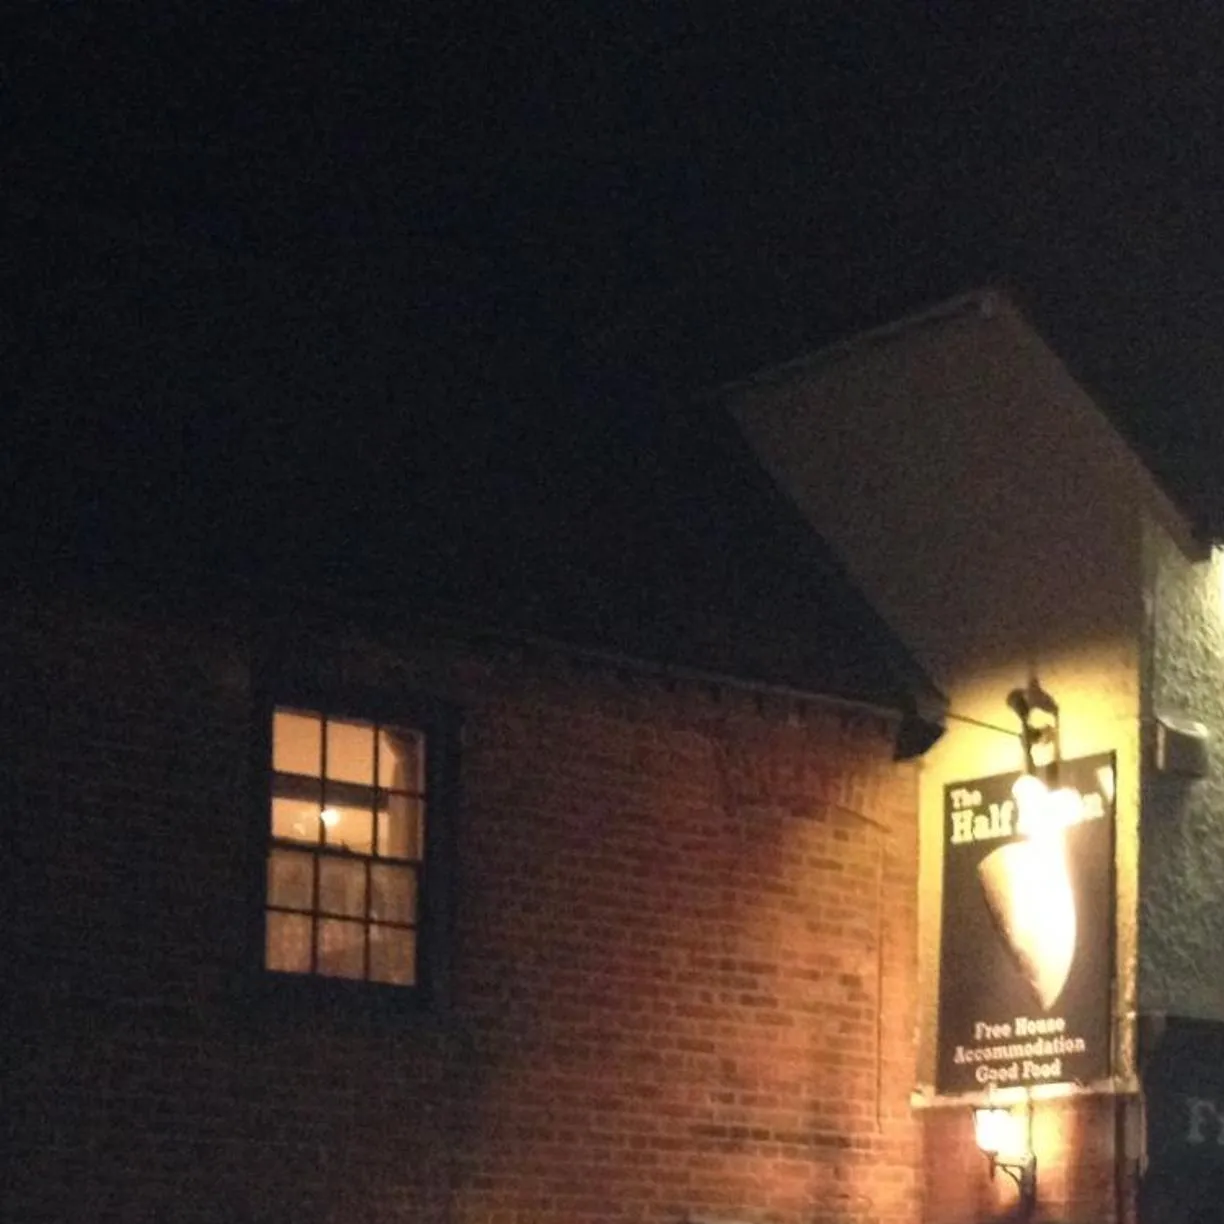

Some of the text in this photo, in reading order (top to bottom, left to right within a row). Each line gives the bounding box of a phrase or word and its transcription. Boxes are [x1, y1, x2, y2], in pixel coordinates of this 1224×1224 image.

[951, 788, 981, 809] The
[951, 801, 1014, 844] Half
[975, 1016, 1065, 1040] Free House
[954, 1036, 1085, 1064] Accommodation
[975, 1059, 1061, 1083] Good Food
